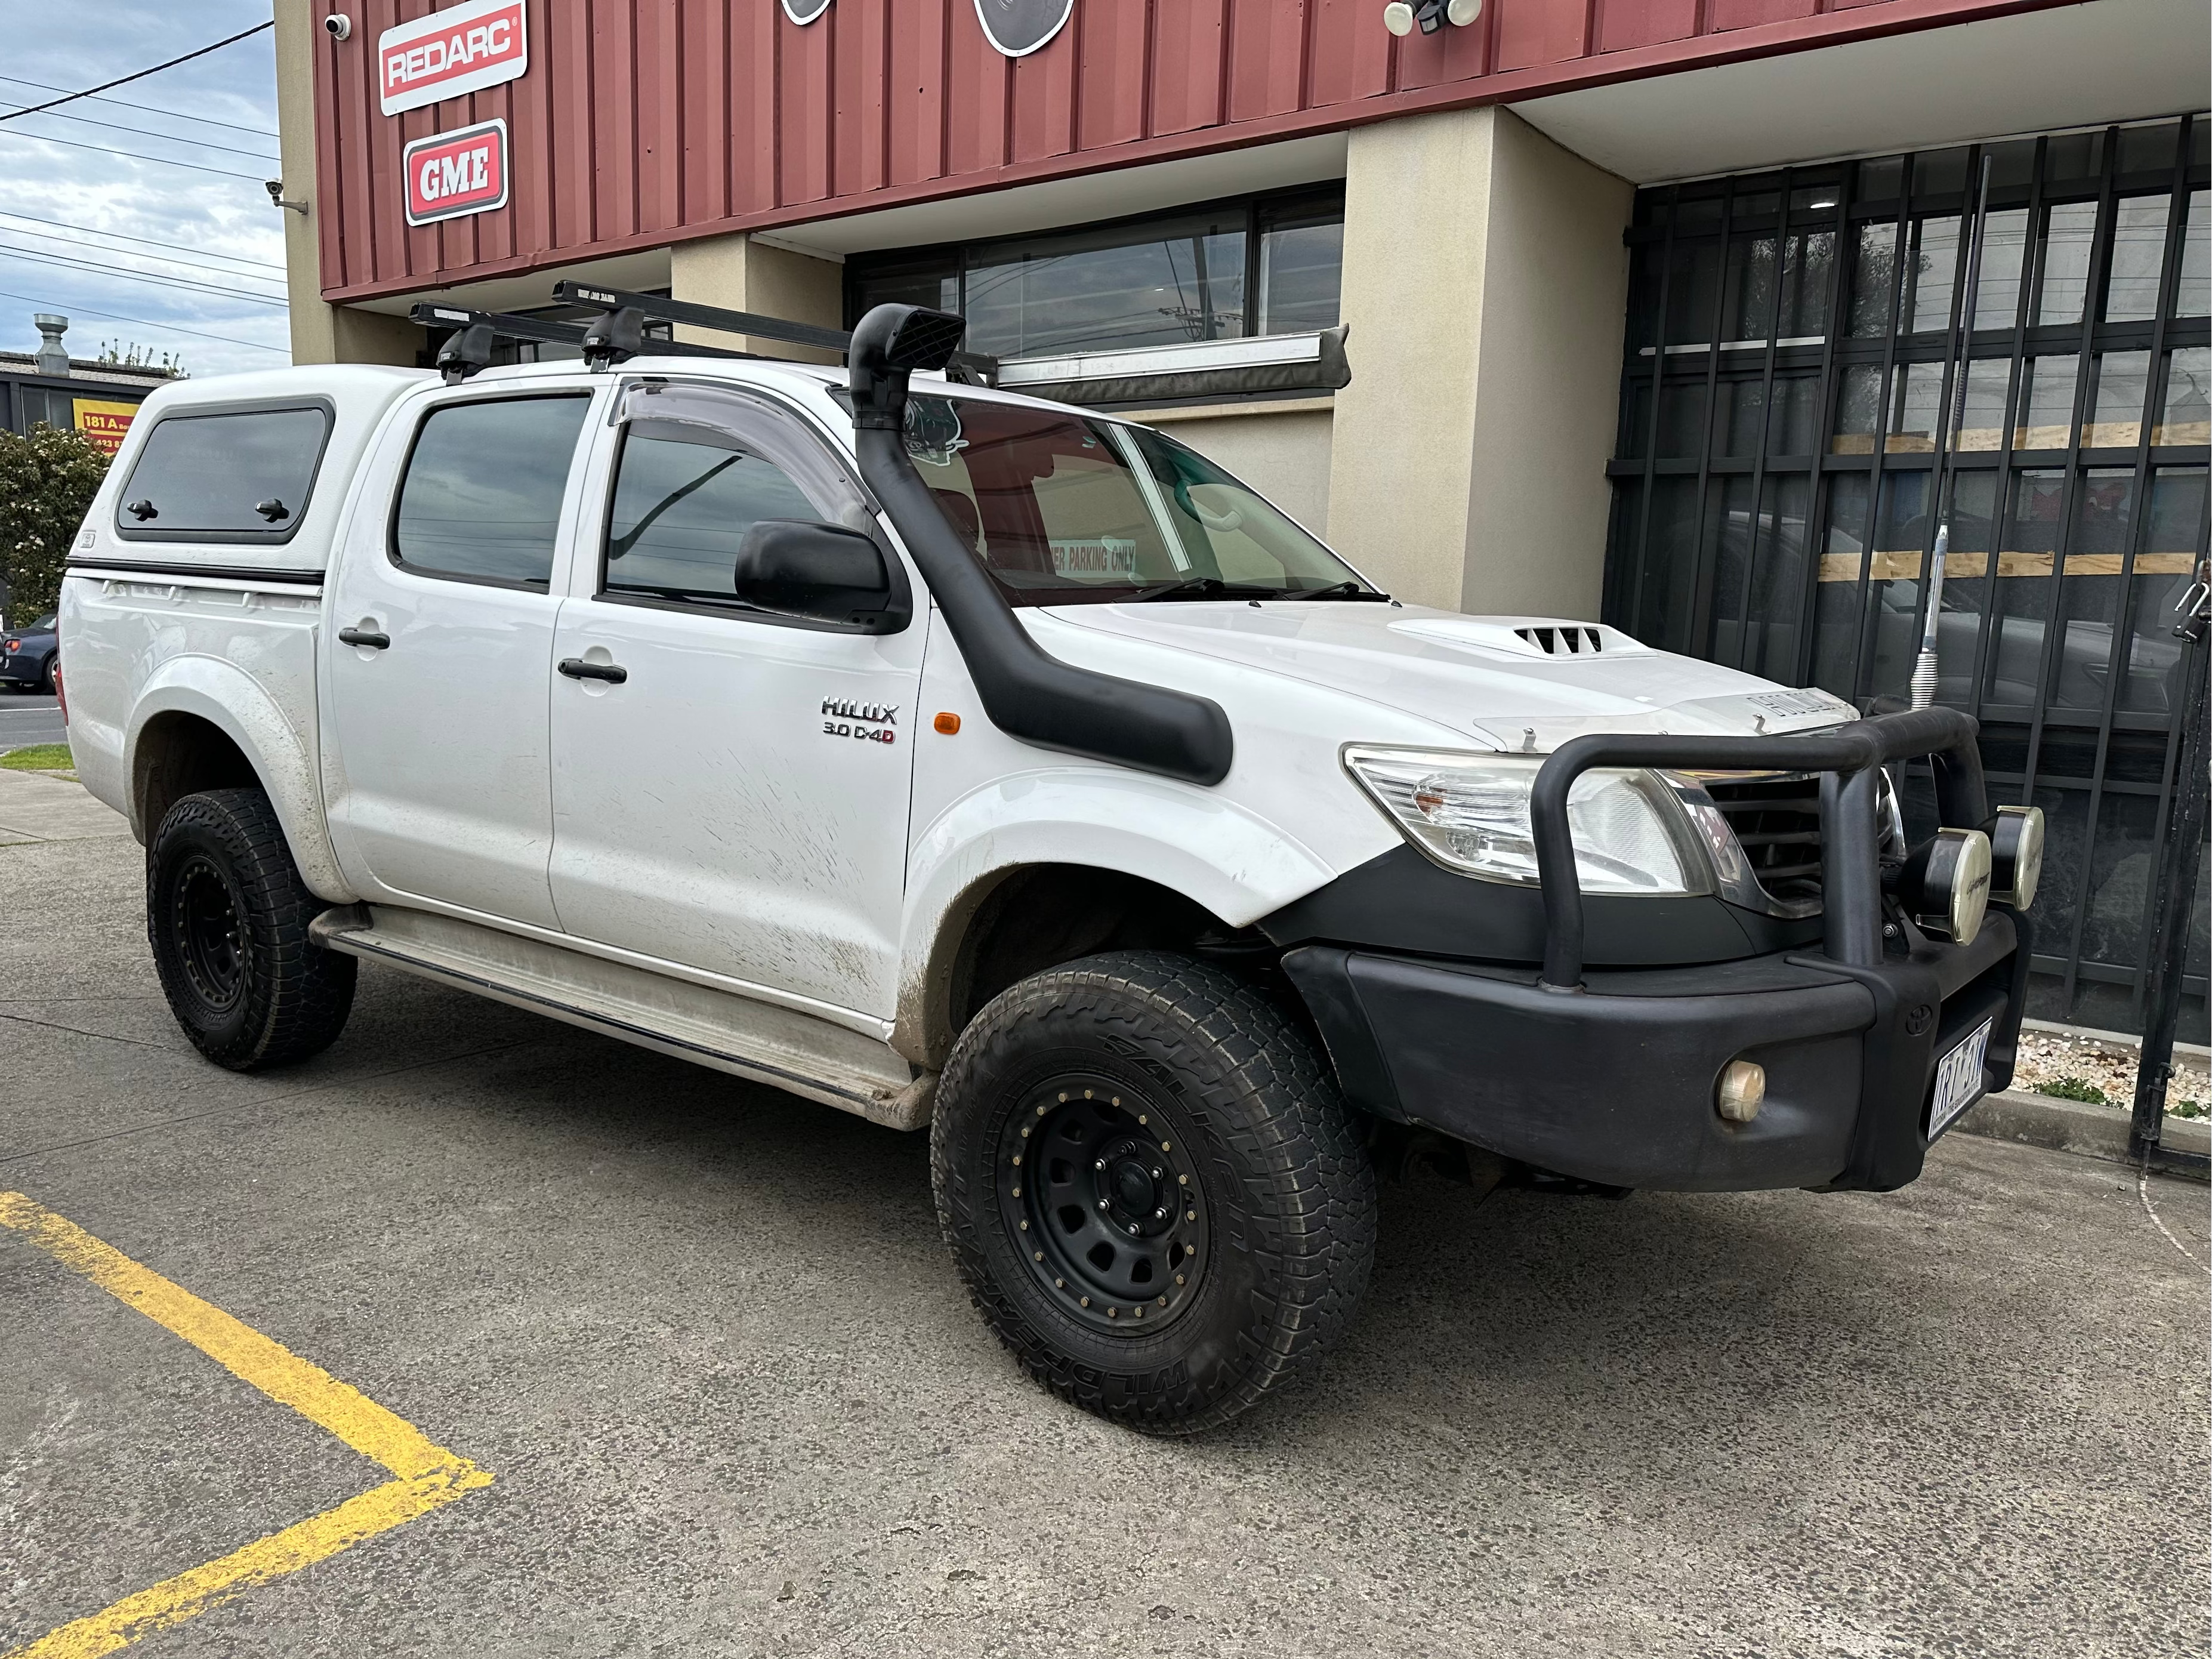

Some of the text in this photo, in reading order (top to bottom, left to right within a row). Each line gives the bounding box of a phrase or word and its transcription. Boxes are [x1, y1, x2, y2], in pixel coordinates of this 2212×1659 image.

[388, 18, 511, 88] REDARC
[420, 147, 488, 201] GME
[85, 416, 105, 428] 181
[107, 418, 118, 429] A
[1069, 546, 1107, 572] PARKING
[1111, 545, 1135, 572] ONLY
[821, 695, 900, 726] HILUX
